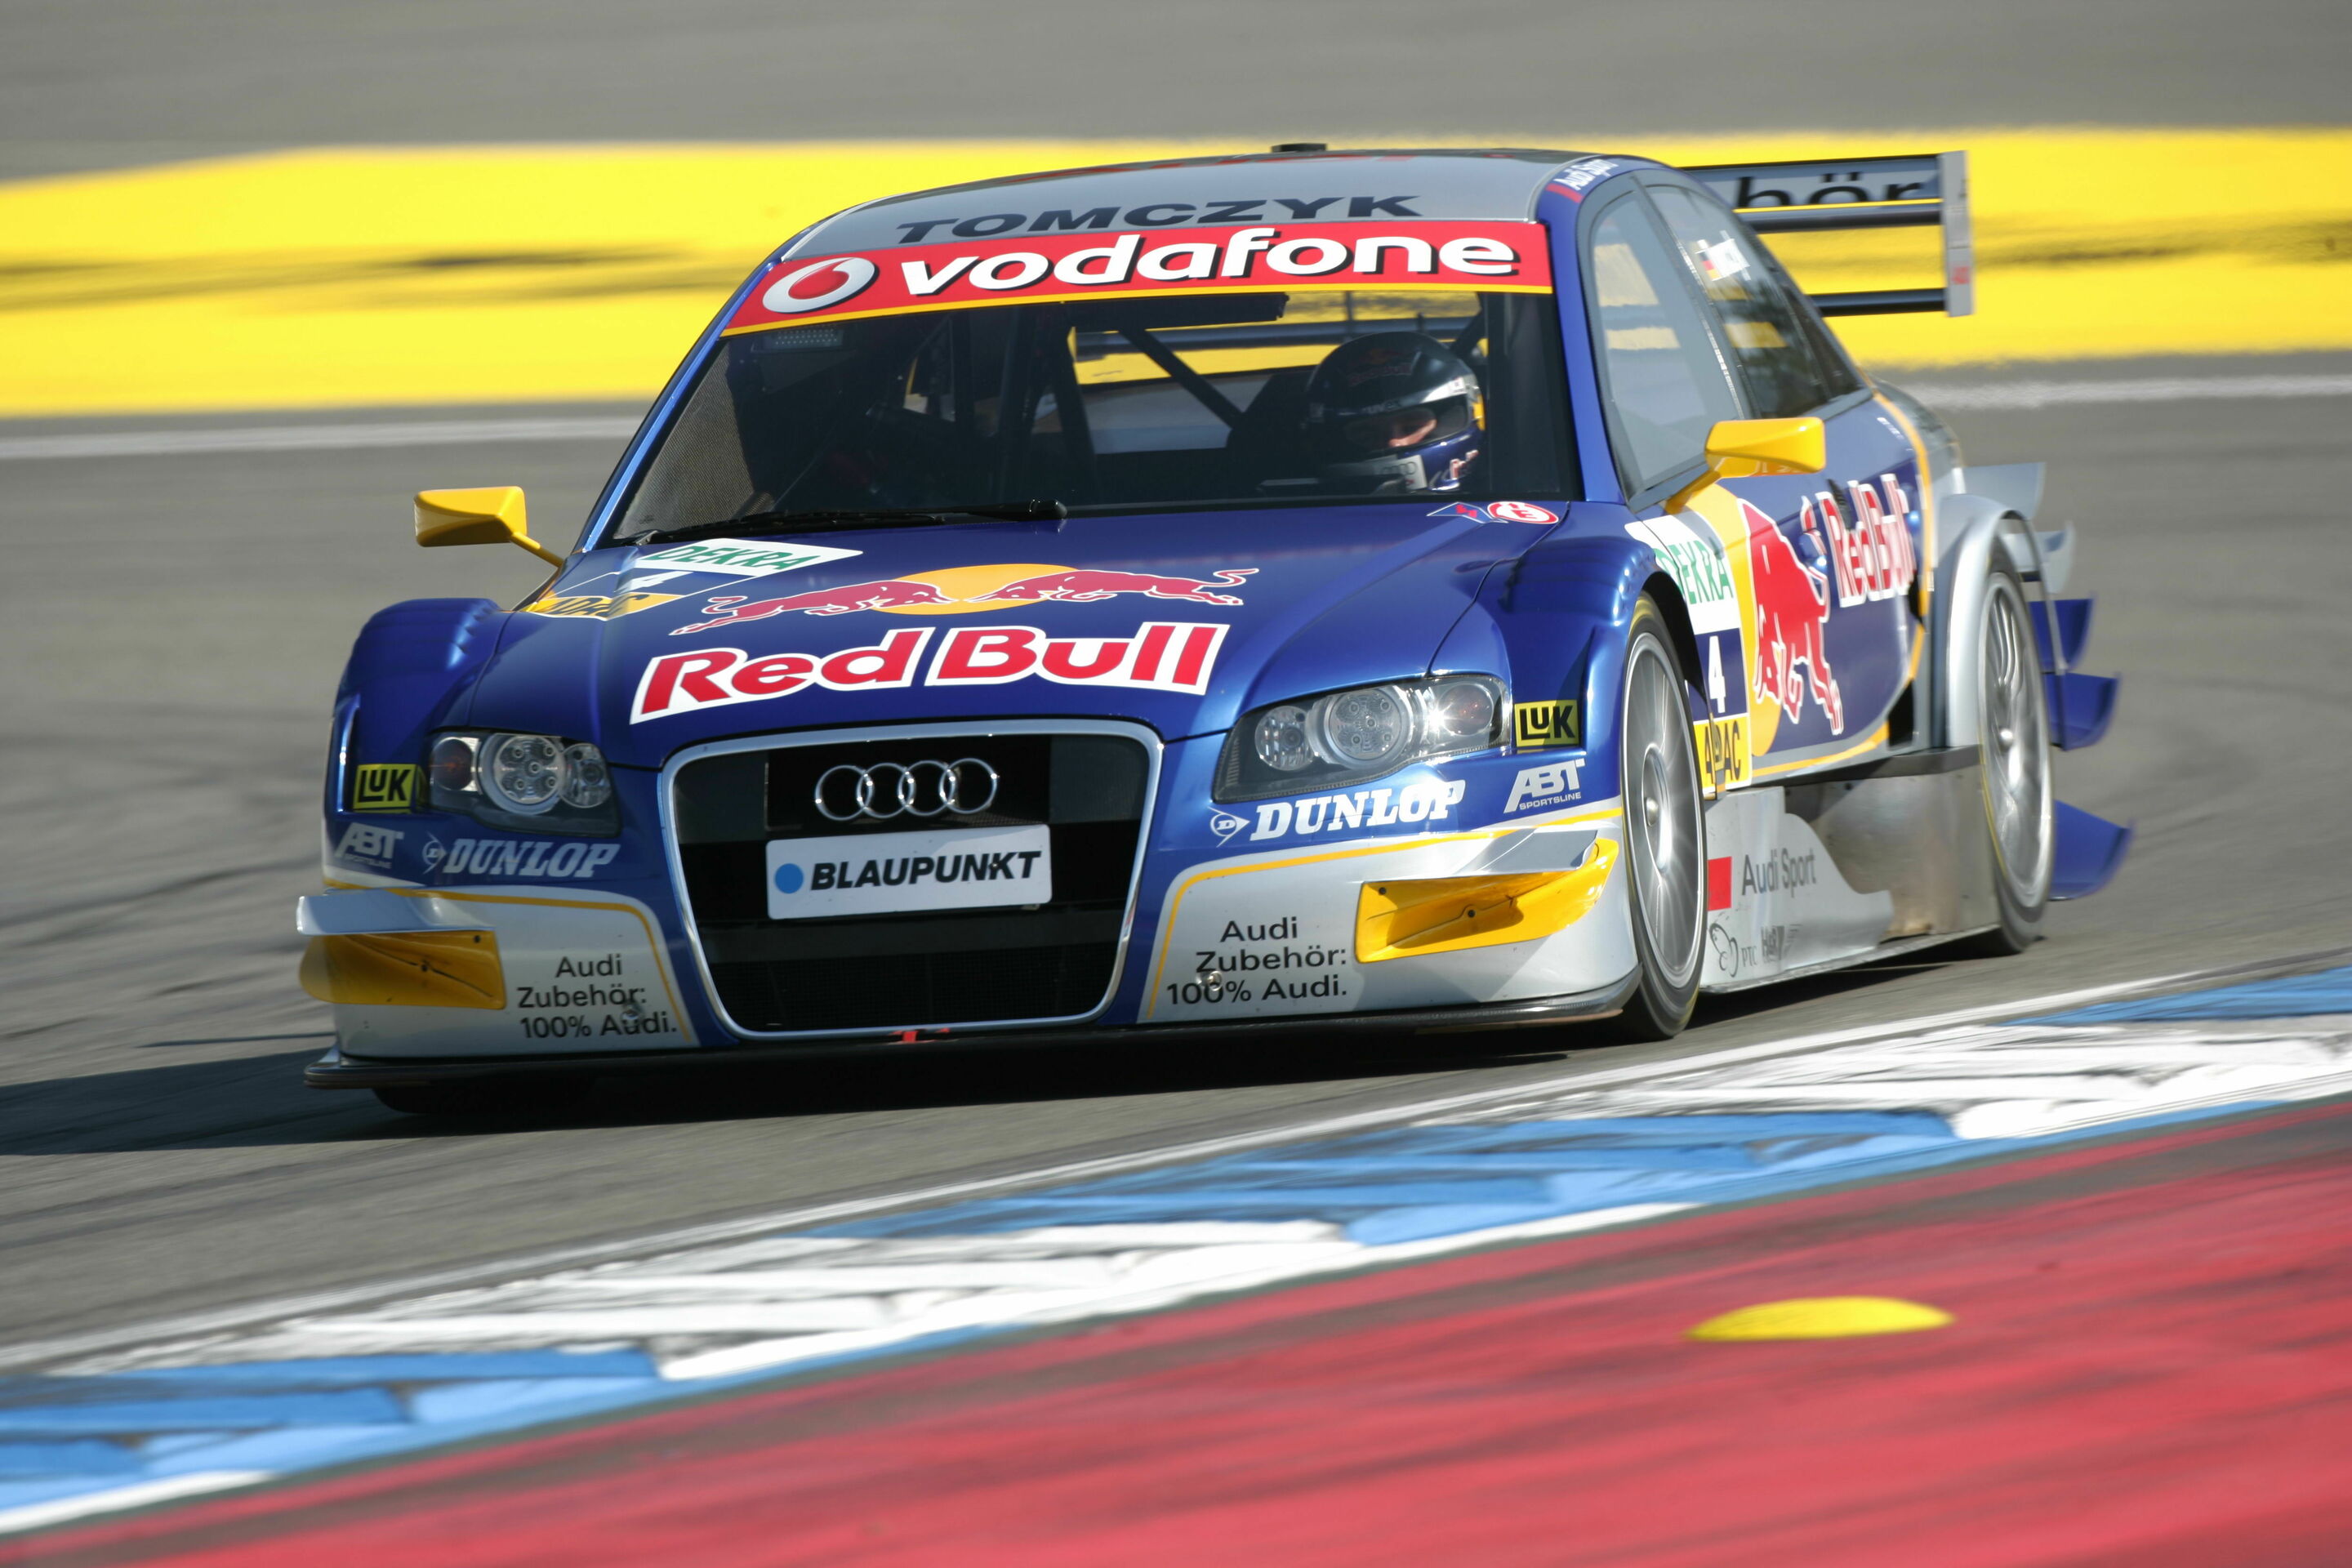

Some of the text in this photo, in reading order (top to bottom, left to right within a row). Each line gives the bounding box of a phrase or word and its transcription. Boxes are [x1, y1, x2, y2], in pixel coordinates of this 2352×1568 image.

[897, 196, 1423, 244] TOMCZYK
[901, 227, 1521, 296] vodafone
[640, 546, 822, 570] DEKRA
[1815, 480, 1881, 608] Red
[1651, 540, 1734, 605] DEKRA
[635, 624, 1223, 719] Red Bull
[1708, 635, 1726, 714] 4
[1704, 719, 1741, 785] ADAC
[1503, 758, 1586, 813] ABT
[1519, 791, 1581, 810] SPORTSLINE
[1250, 779, 1465, 841] DUNLOP
[334, 822, 405, 858] ABT
[442, 838, 621, 878] DUNLOP
[810, 851, 1041, 890] BLAUPUNKT
[1741, 847, 1816, 899] Audi Sport
[1220, 917, 1298, 943] Audi
[555, 954, 622, 978] Audi
[1196, 947, 1346, 973] Zubehör:
[517, 984, 647, 1008] Zubehör:
[1167, 974, 1348, 1004] 100% Audi.
[520, 1011, 678, 1039] 100% Audi.
